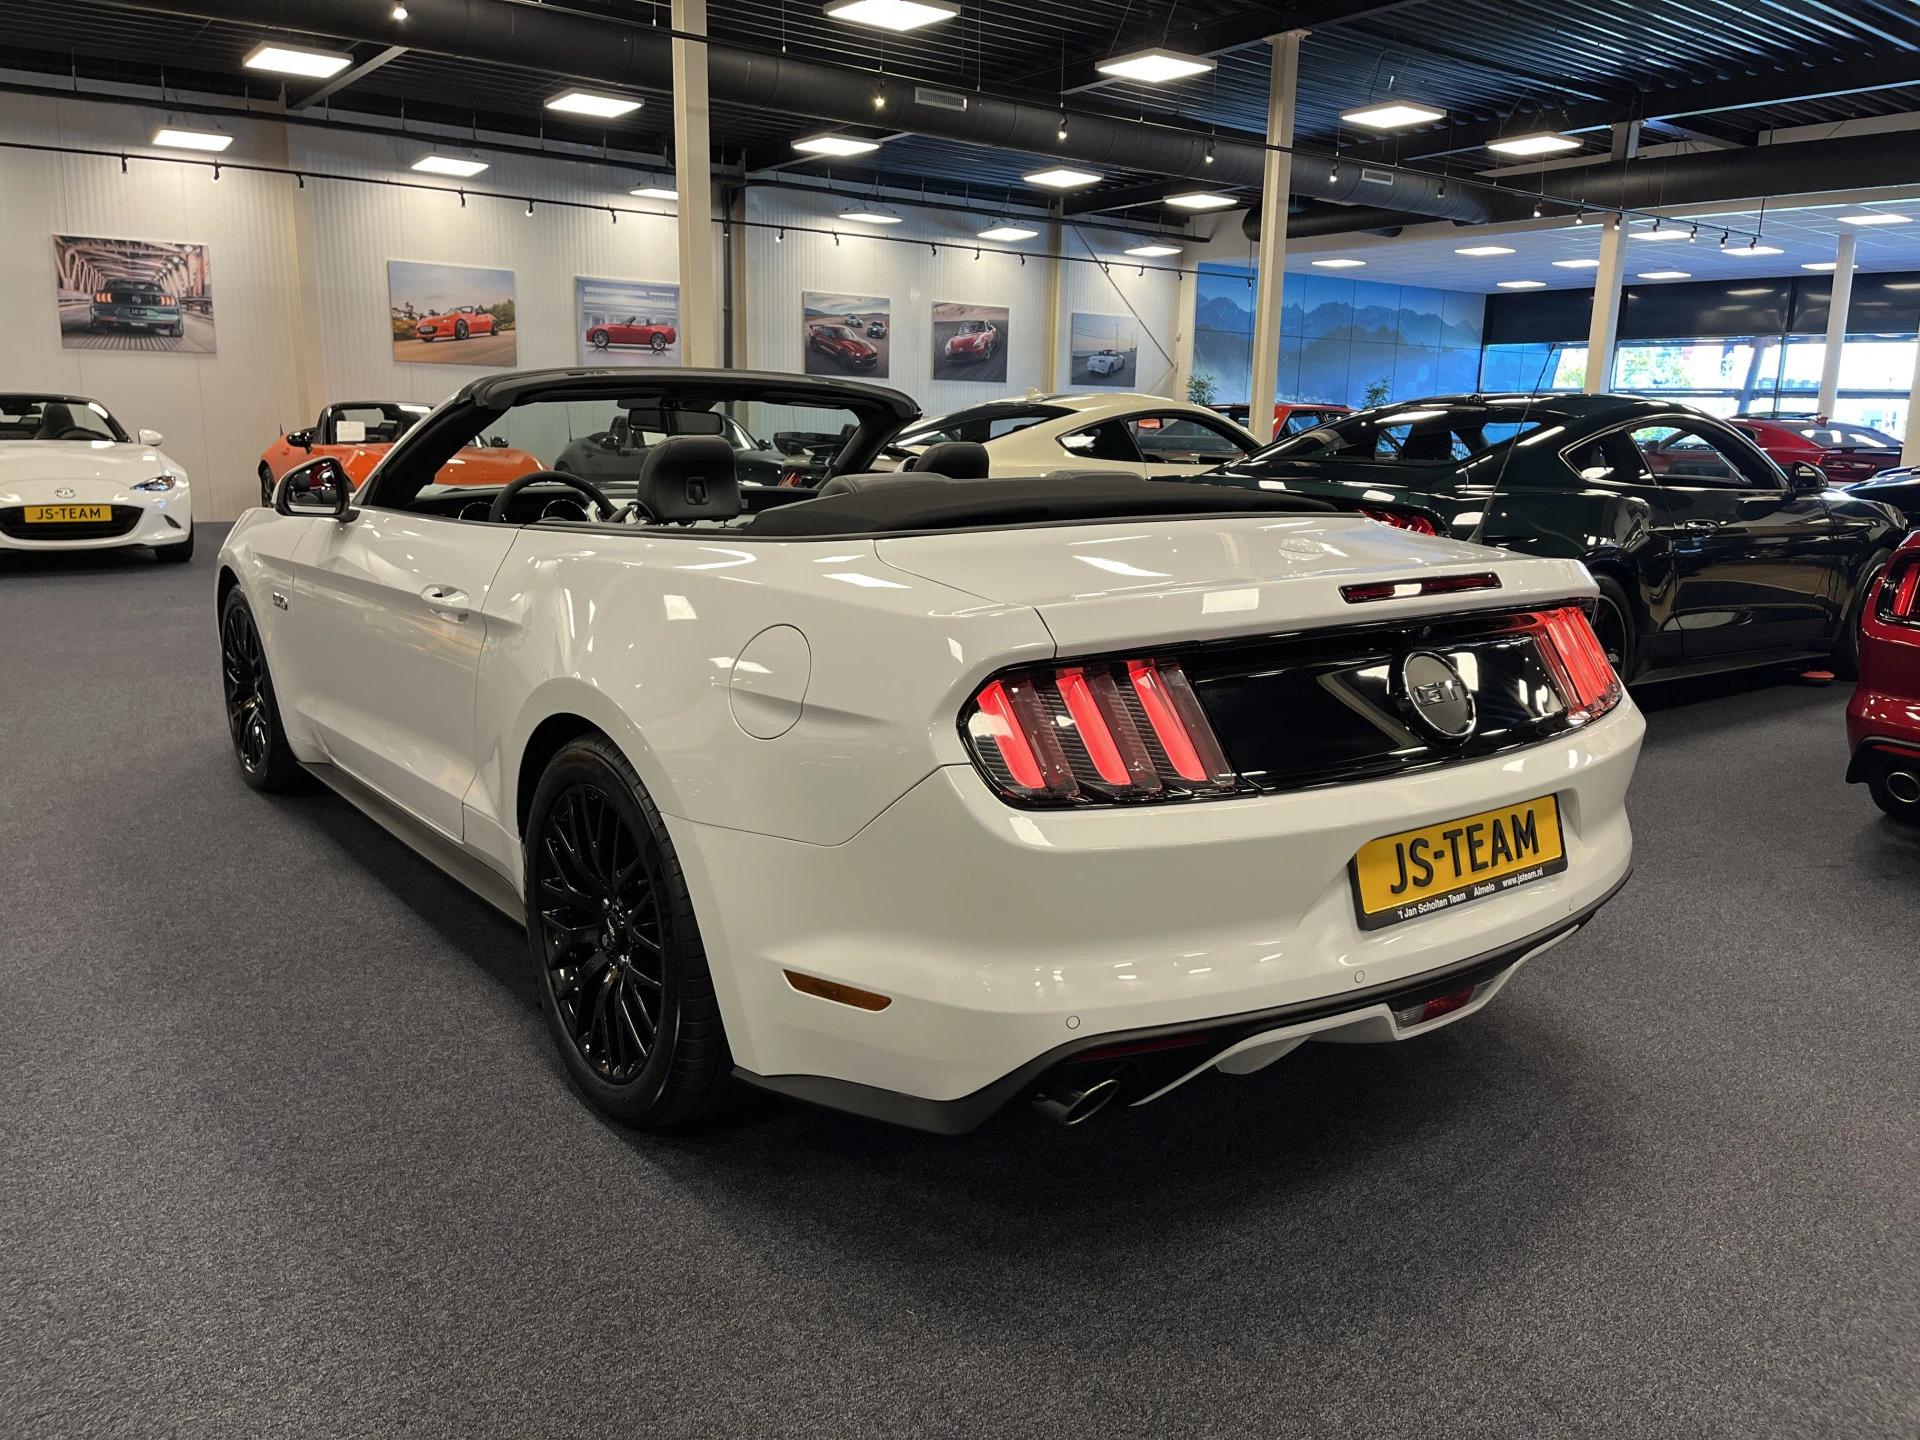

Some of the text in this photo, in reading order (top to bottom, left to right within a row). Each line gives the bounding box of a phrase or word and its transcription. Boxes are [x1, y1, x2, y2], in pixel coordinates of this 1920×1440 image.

[37, 508, 101, 519] JS-TEAM
[1391, 810, 1540, 894] JS-TEAM
[1404, 907, 1418, 918] Jan
[1418, 897, 1448, 914] Scholten
[1448, 892, 1467, 905] Team
[1473, 882, 1496, 897] Almelo
[1502, 866, 1544, 887] www.jsteam.nl
